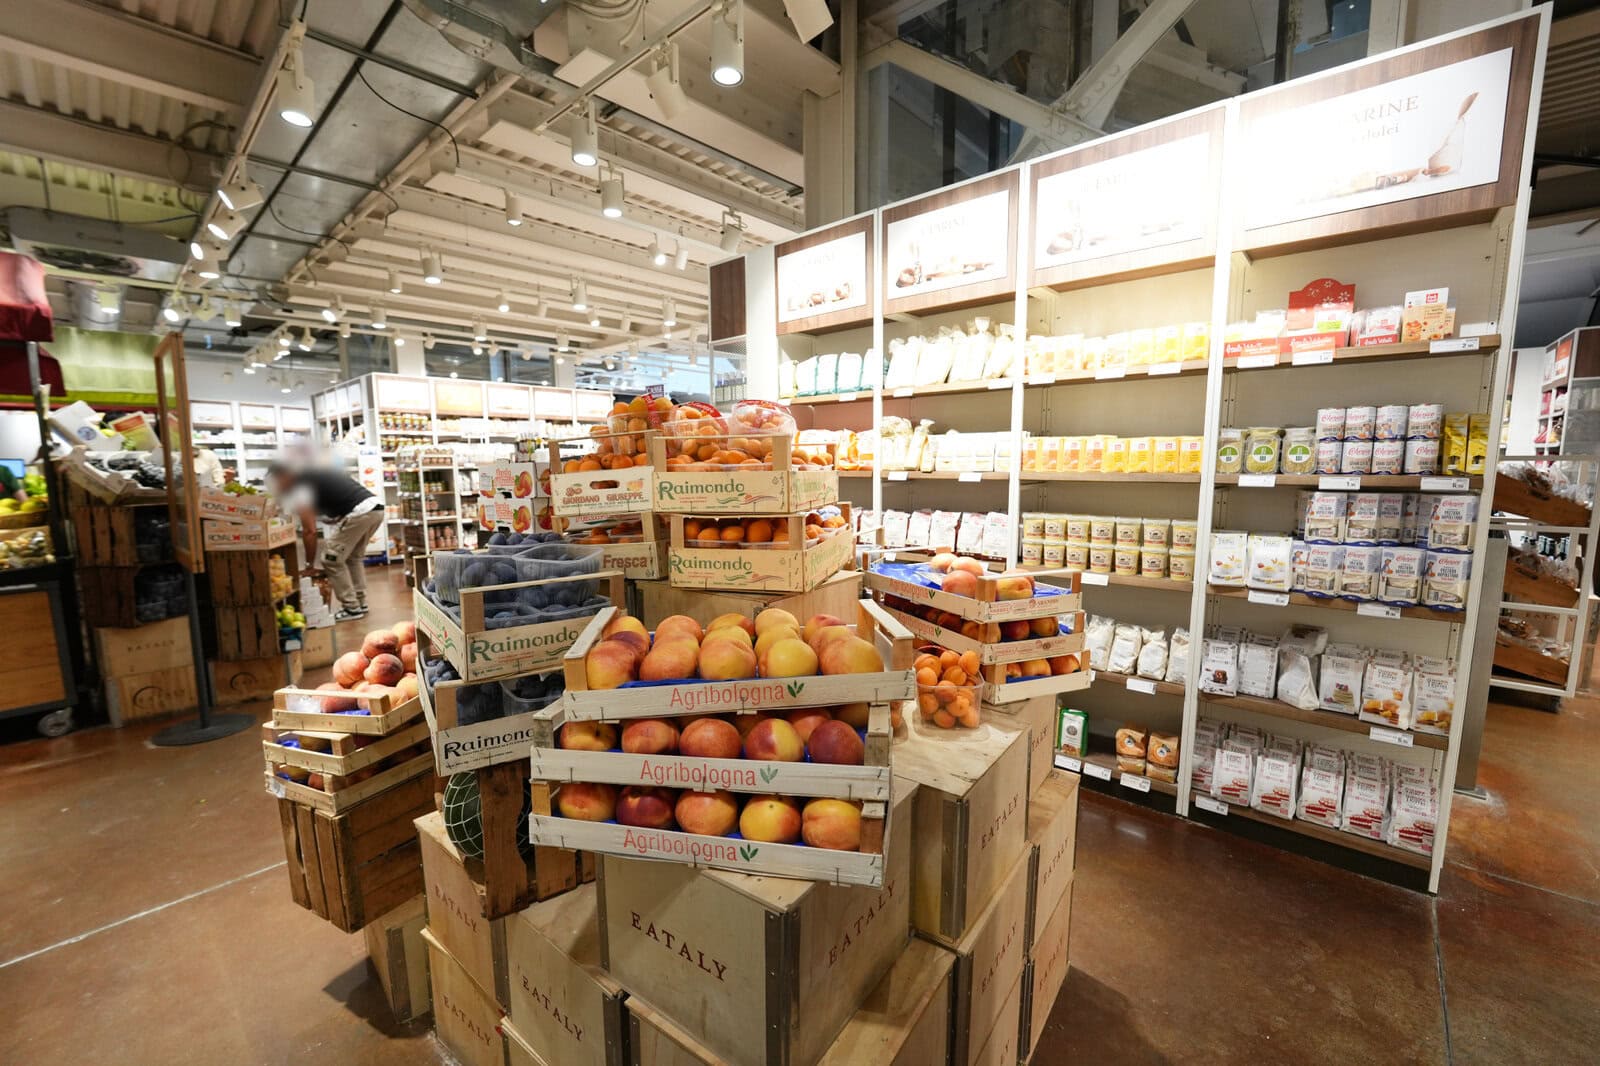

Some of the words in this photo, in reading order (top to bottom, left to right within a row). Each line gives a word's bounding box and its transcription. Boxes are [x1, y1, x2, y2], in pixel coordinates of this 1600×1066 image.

[658, 478, 745, 501] Raimondo
[602, 554, 648, 569] Fresca
[669, 554, 752, 575] Raimondo
[468, 626, 579, 665] Raimondo
[669, 682, 785, 711] Agribologna
[443, 726, 534, 760] Raimon
[640, 759, 757, 789] Agribologna
[981, 792, 1019, 850] EATALY
[623, 828, 738, 863] Agribologna
[434, 883, 479, 934] EATALY
[829, 879, 895, 969] EATALY
[630, 910, 728, 983] EATALY
[443, 995, 492, 1047] EATALY
[521, 975, 583, 1043] EATALY
